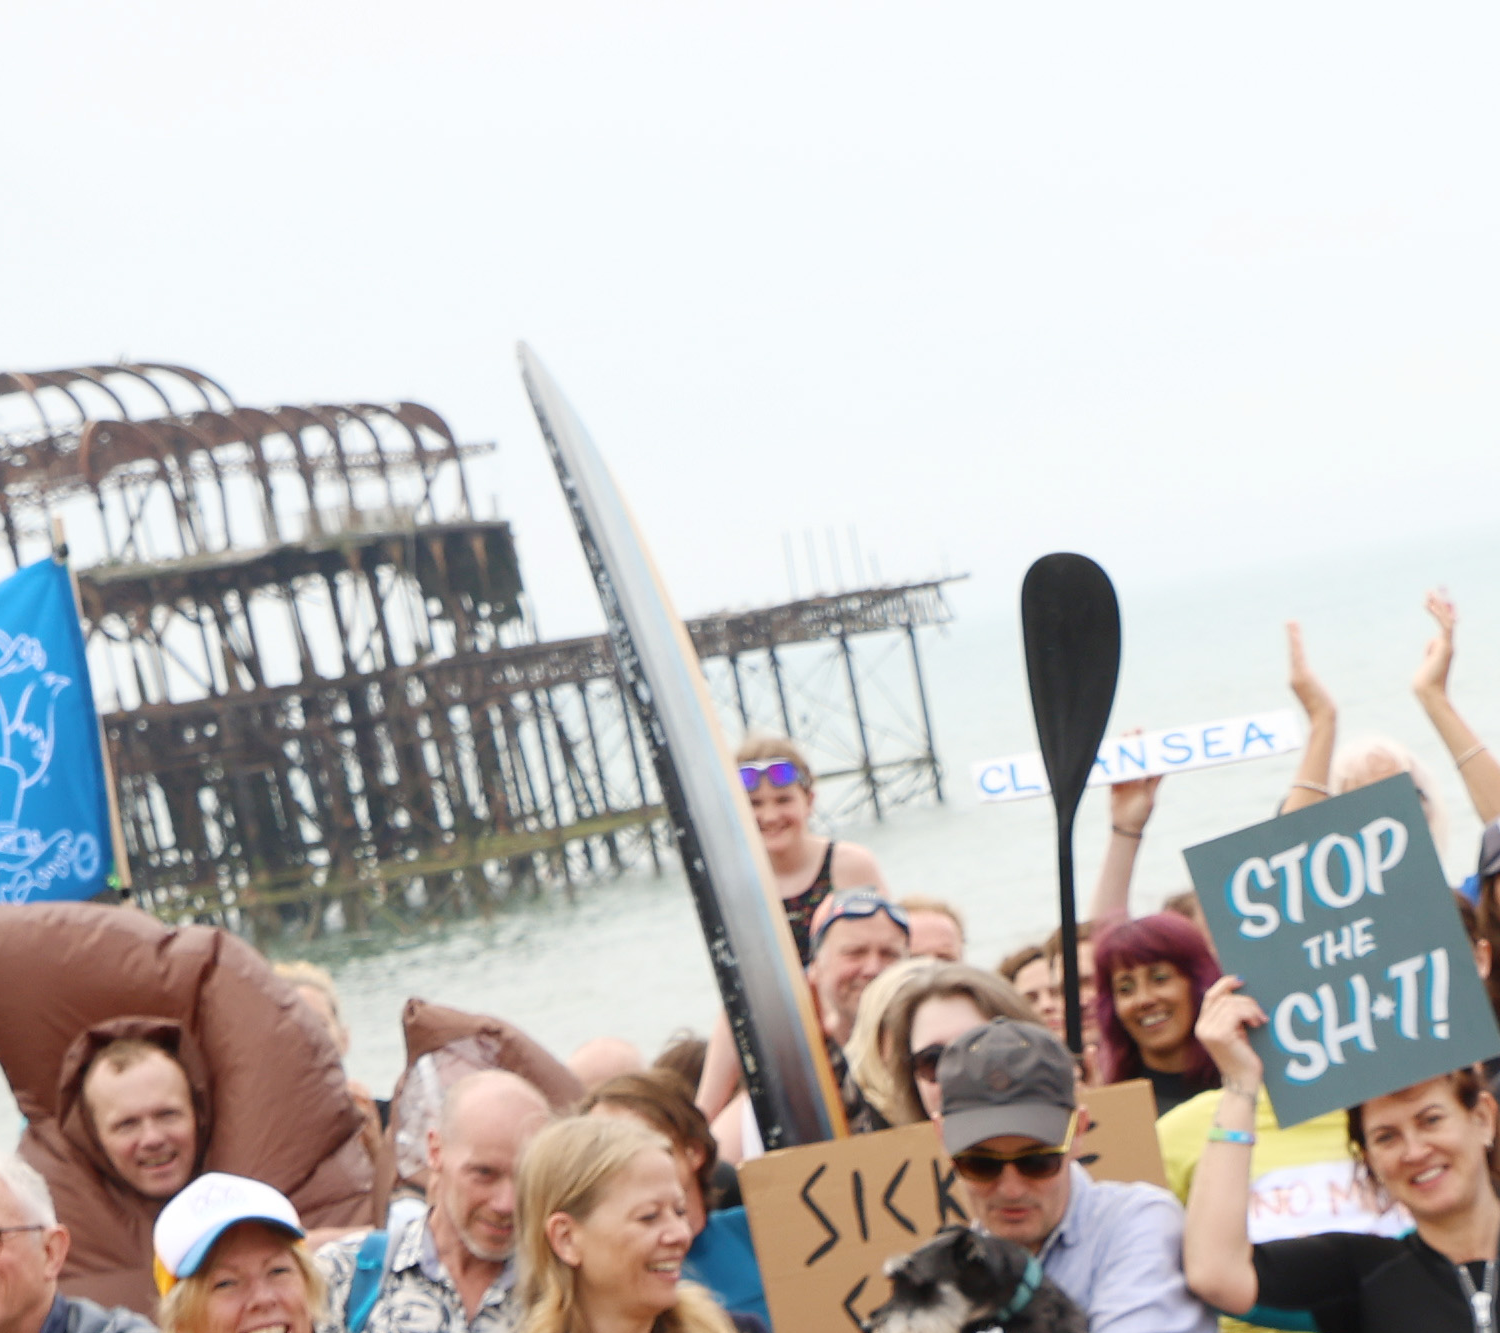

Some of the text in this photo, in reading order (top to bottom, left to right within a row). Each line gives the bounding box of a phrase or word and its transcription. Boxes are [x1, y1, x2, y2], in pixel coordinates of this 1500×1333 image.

[979, 720, 1275, 795] CLN SEA
[1225, 816, 1409, 939] STOP
[1301, 916, 1377, 970] THE
